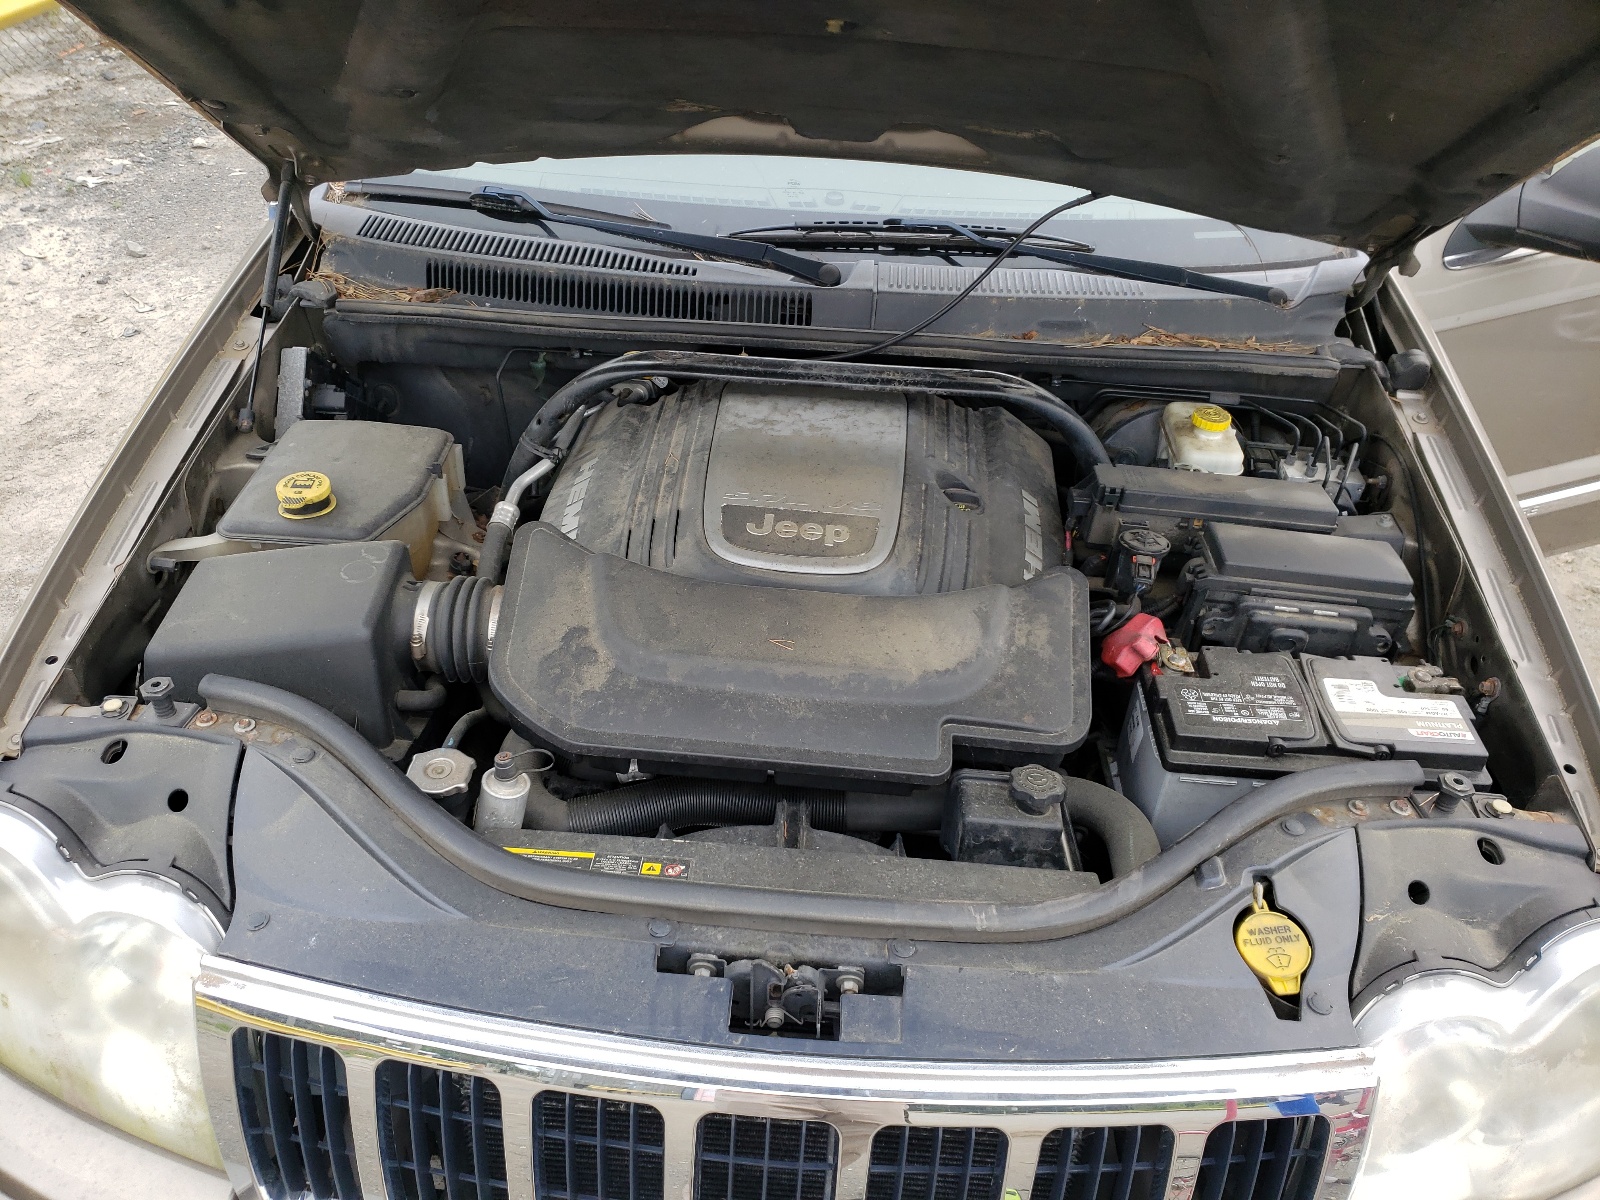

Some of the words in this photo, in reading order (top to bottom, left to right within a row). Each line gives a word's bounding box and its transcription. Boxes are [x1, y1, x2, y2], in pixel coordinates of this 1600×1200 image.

[745, 513, 850, 547] Jeep
[1415, 720, 1463, 729] PLATINUM
[1246, 925, 1292, 936] WASHER
[1242, 936, 1273, 947] FLUID
[1274, 934, 1301, 945] ONLY
